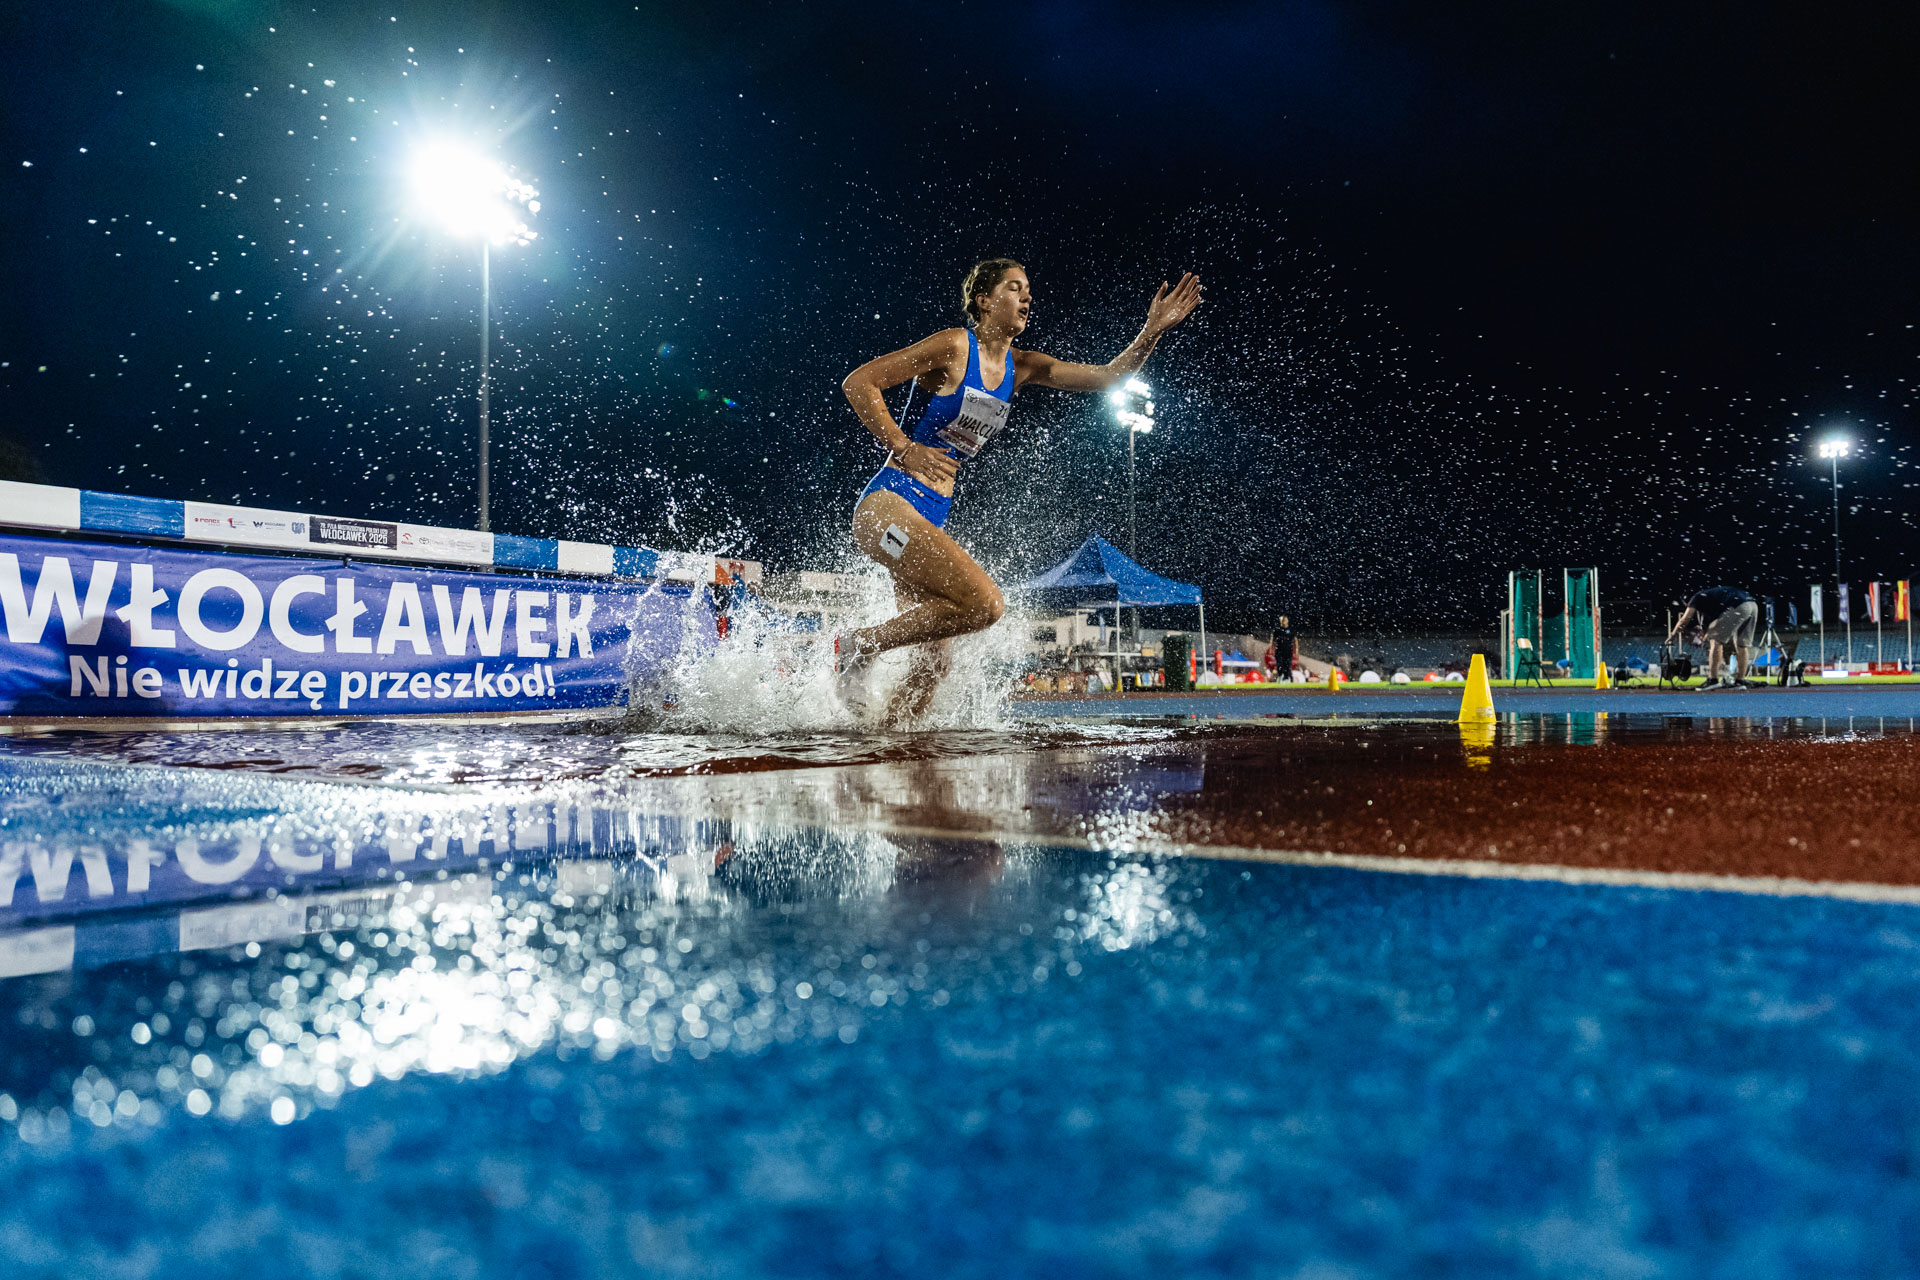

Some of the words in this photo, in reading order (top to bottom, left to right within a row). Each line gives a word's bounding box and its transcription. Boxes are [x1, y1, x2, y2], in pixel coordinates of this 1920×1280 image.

[320, 528, 367, 543] WŁOCŁAWEK
[0, 552, 595, 660] WŁOCŁAWEK
[69, 654, 163, 698] Nie
[178, 657, 327, 711] widzę
[339, 662, 556, 710] przeszkód!
